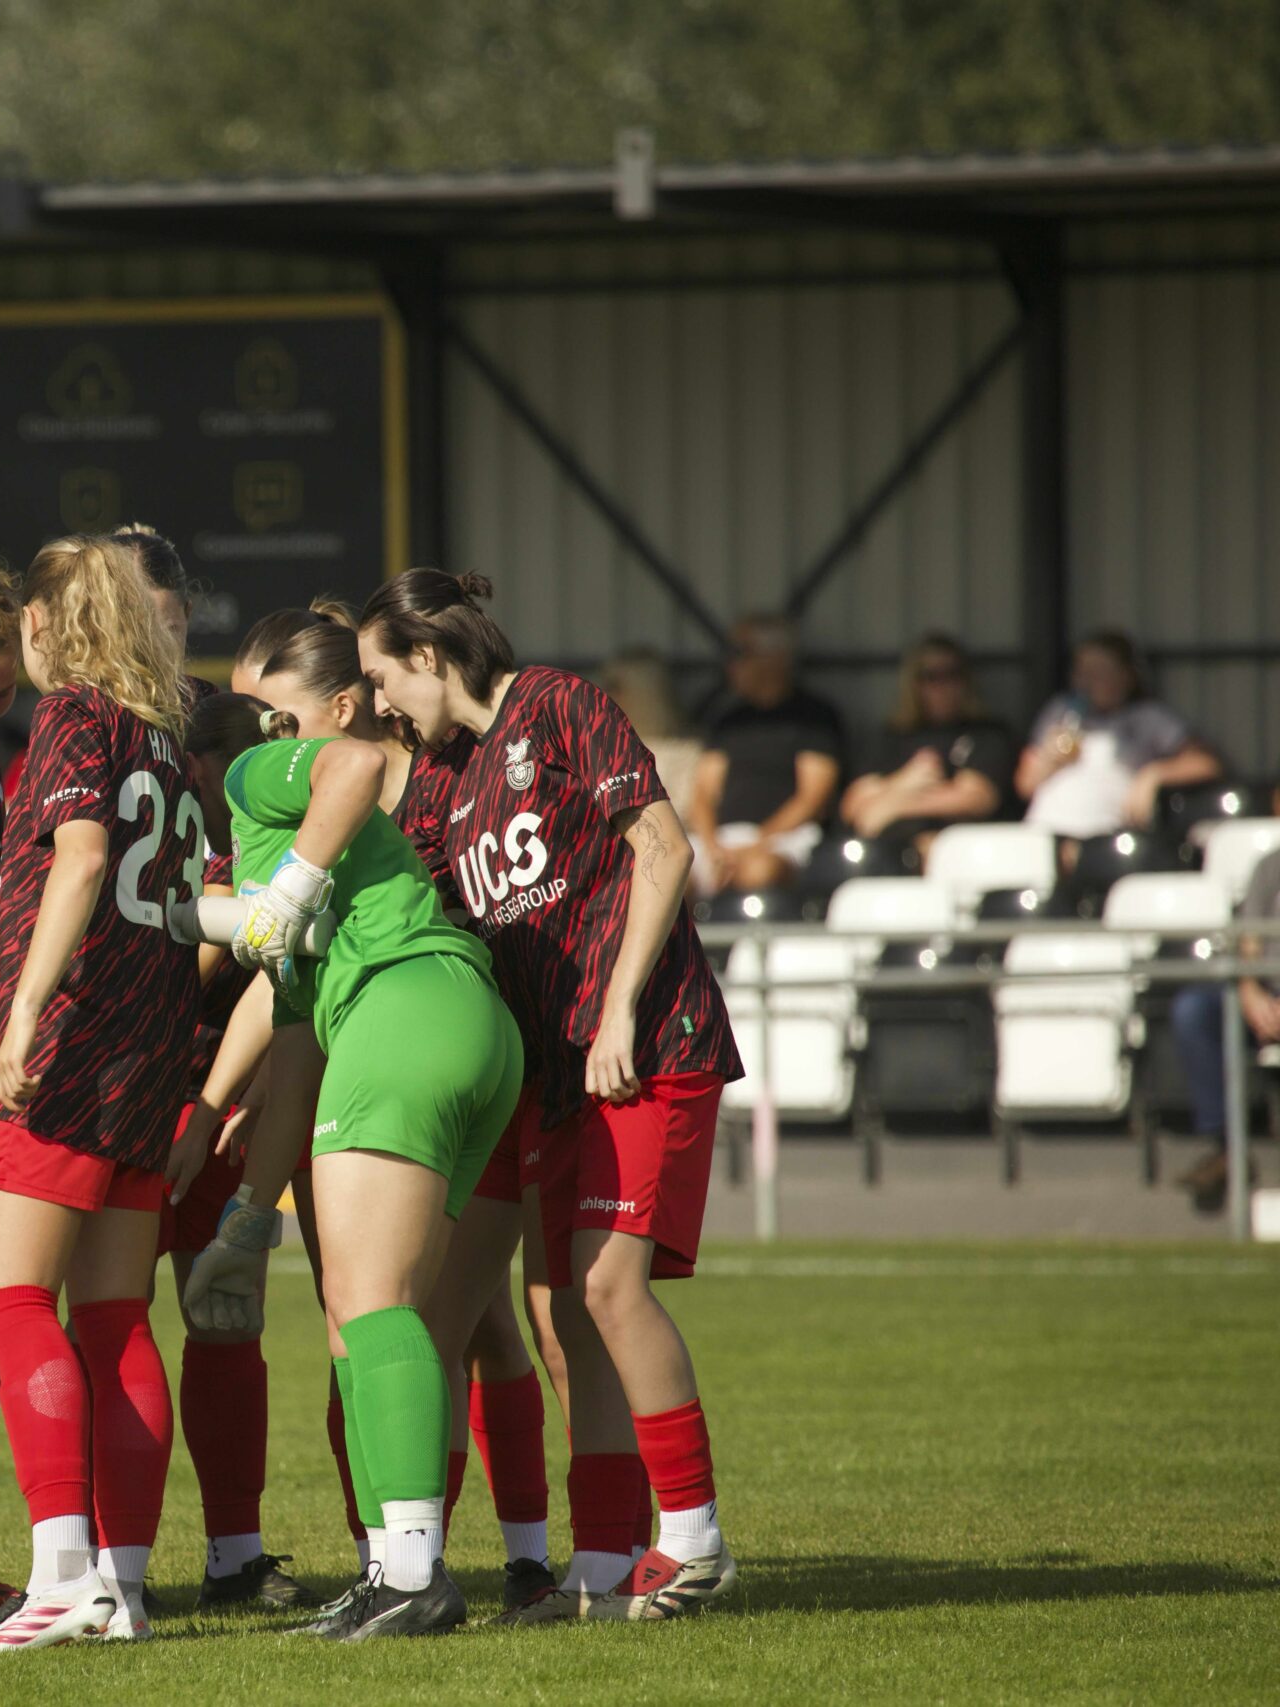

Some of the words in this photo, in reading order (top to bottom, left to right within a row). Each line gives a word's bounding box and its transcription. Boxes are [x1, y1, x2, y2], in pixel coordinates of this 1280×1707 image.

[43, 787, 100, 806] SHEPPY'S
[116, 770, 205, 946] 23
[458, 812, 548, 918] UCS
[579, 1196, 636, 1213] uhlsport
